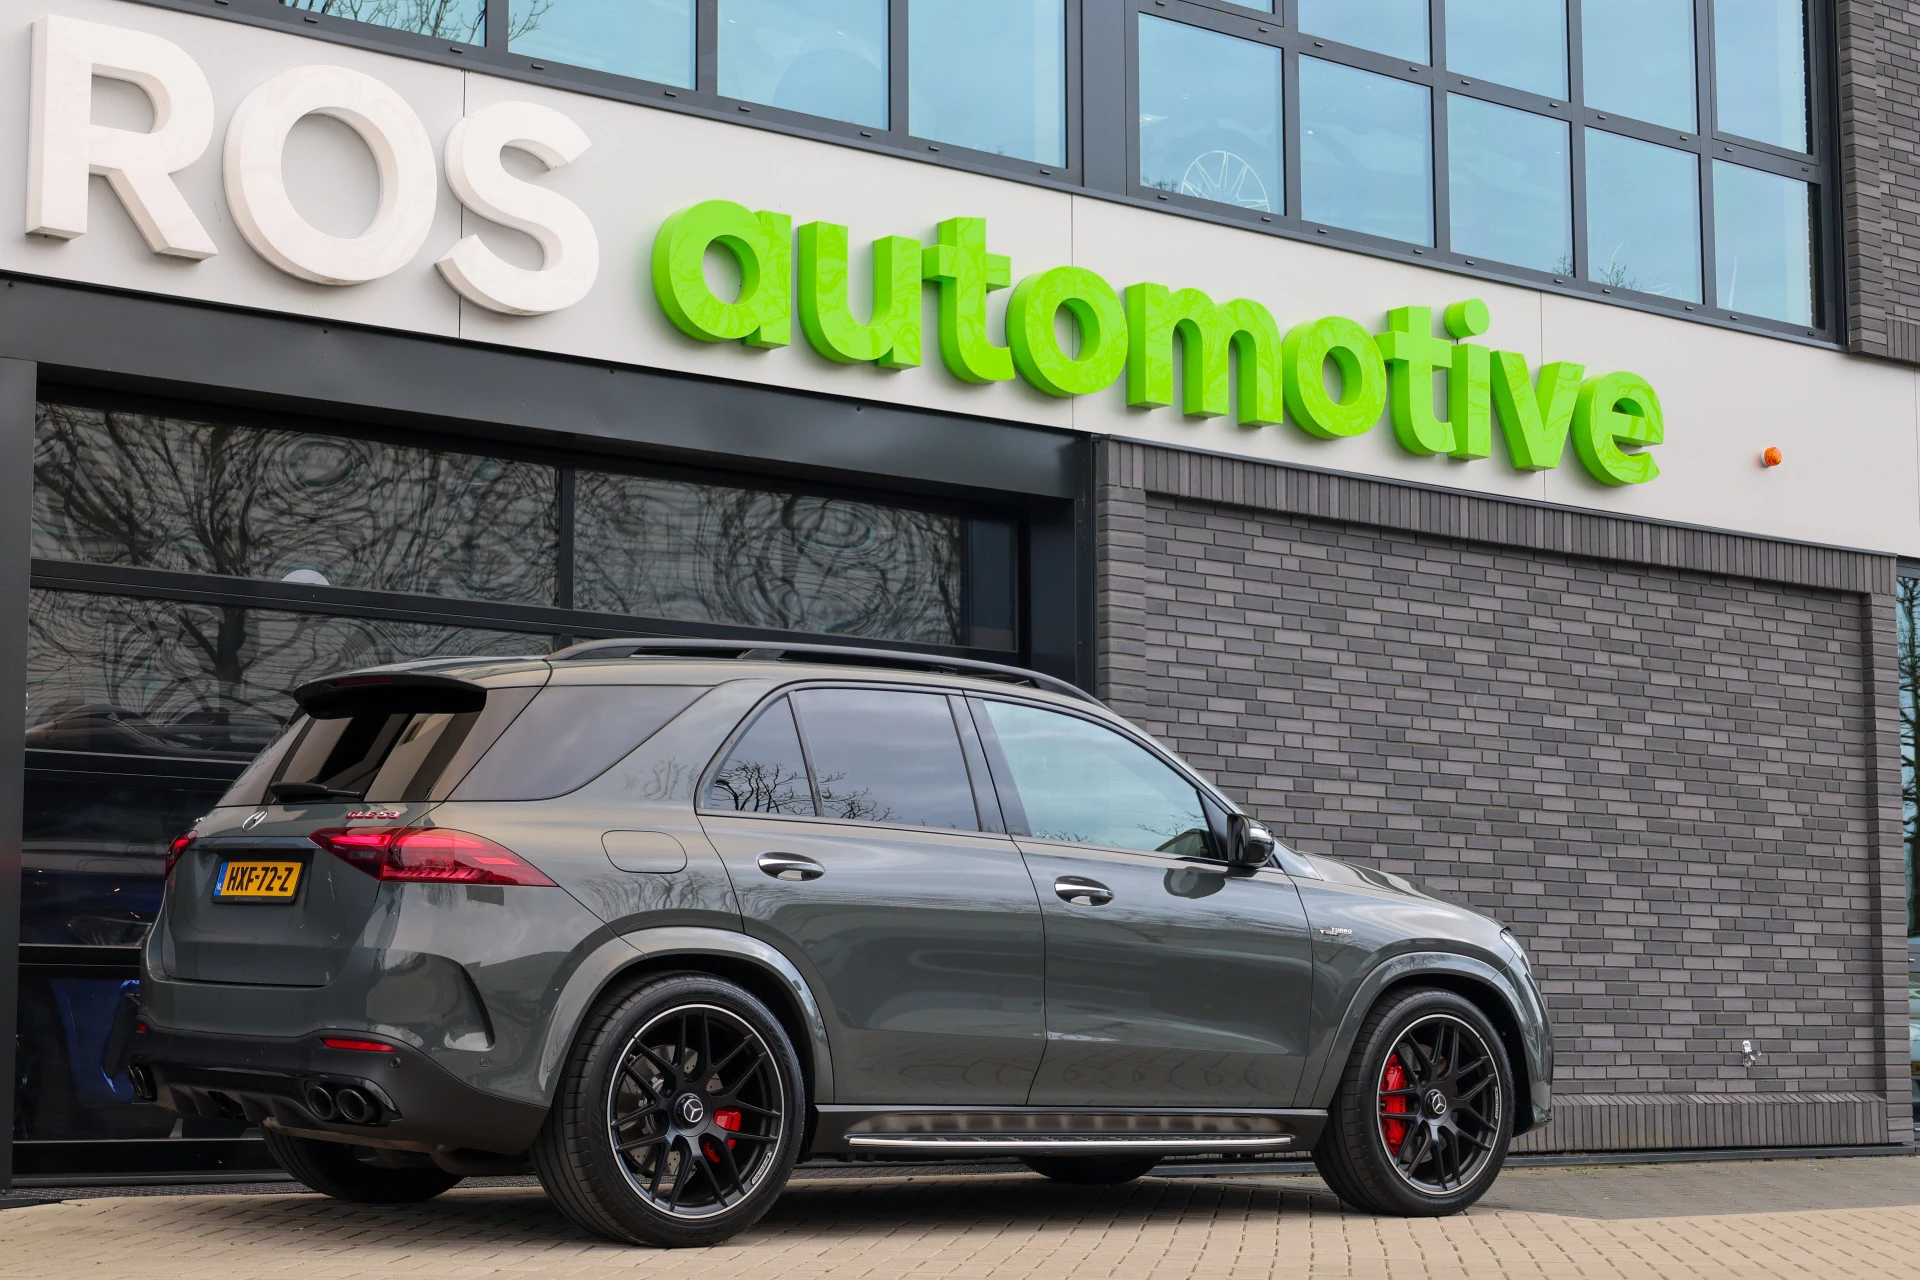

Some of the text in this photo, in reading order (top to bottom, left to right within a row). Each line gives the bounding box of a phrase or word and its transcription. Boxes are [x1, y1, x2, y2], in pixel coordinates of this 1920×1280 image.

[26, 14, 1664, 486] ROS automotive
[226, 866, 294, 892] HXF-72-Z
